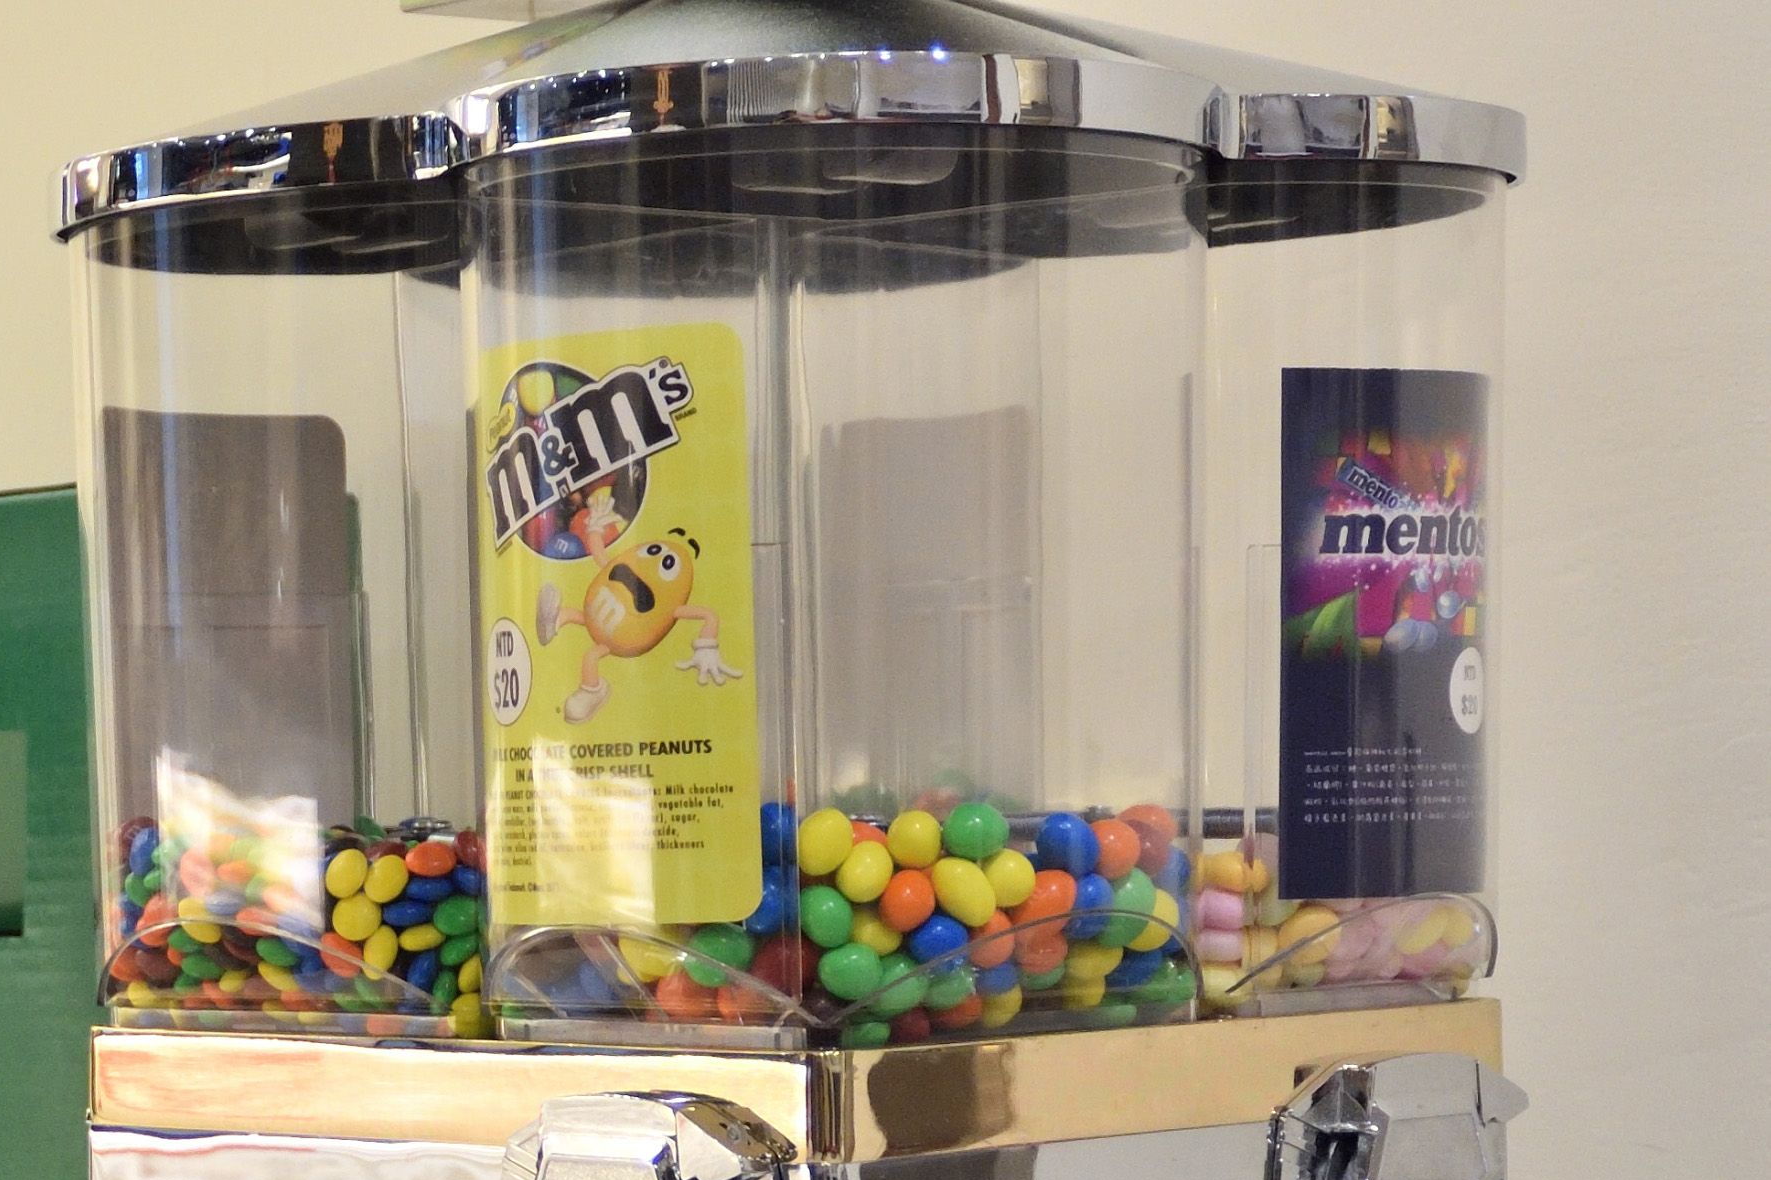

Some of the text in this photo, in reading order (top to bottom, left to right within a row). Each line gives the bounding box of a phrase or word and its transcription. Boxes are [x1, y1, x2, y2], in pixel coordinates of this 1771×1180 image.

[495, 631, 514, 657] NTD
[493, 667, 519, 712] $20
[569, 742, 634, 758] COVERED
[639, 739, 713, 756] PEANUTS
[515, 769, 525, 783] IN
[609, 764, 655, 779] SHELL
[665, 785, 685, 795] Milk
[689, 782, 734, 795] chocolate
[658, 797, 703, 811] vegetable
